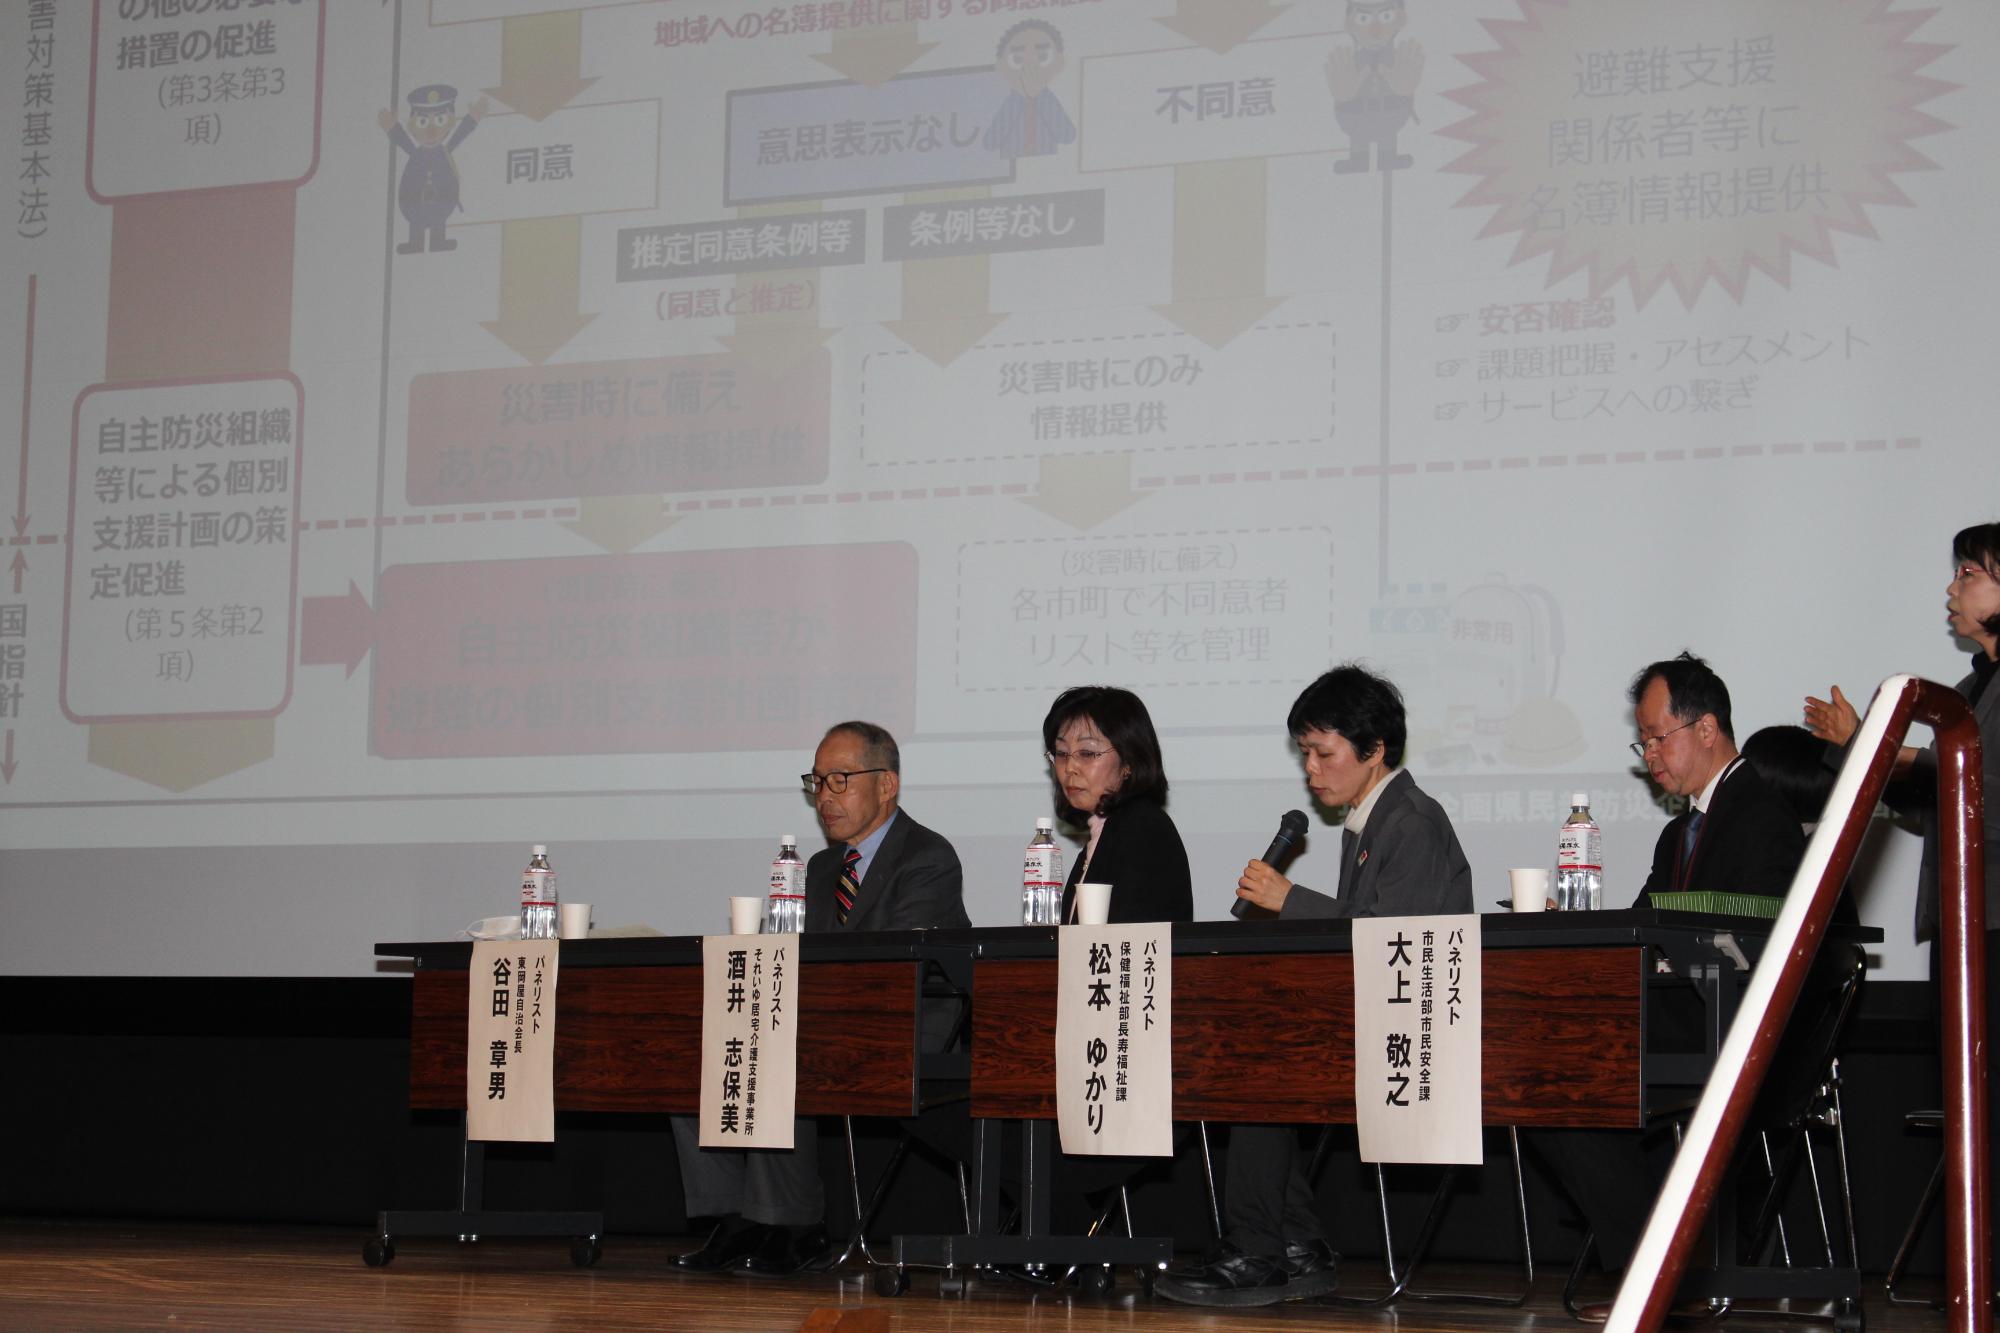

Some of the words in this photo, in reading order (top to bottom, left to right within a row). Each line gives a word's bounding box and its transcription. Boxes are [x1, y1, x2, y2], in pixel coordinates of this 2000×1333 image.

[116, 19, 277, 70] 措置の促進
[1571, 33, 1777, 101] 避難支援
[158, 67, 286, 109] (第3条第3
[1154, 77, 1277, 125] 不同意
[183, 113, 222, 145] 項)
[756, 111, 980, 166] 意思表示なし
[1548, 104, 1802, 168] 関係者等に
[505, 143, 575, 184] 同意
[1522, 162, 1833, 235] 名簿情報提供
[631, 219, 852, 269] 推定同意条例等
[909, 203, 1076, 247] 条例等なし
[656, 279, 817, 320] (同意と推定)
[1477, 297, 1617, 336] 安否確認
[998, 353, 1203, 396] 災害時にのみ
[1476, 325, 1871, 382] 課題把握・アセスメント
[501, 367, 742, 426] 災害時に備え
[1030, 401, 1168, 440] 情報提供
[1476, 373, 1760, 425] サービスへの繋ぎ
[97, 408, 293, 455] 自主防災組織
[95, 456, 288, 505] 等による個別
[92, 505, 288, 553] 支援計画の策
[88, 559, 186, 601] 定促進
[1060, 541, 1239, 577] (災害時に備え)
[125, 606, 265, 642] (第5条第2
[1009, 576, 1289, 624] 各市町で不同意者
[155, 650, 195, 682] 項)
[1030, 625, 1272, 668] リスト等を管理
[492, 957, 512, 1018] 谷田
[727, 950, 747, 1013] 酒井
[1087, 942, 1112, 1012] 松本
[1387, 931, 1413, 1004] 大上
[1447, 928, 1464, 1026] パネリスト
[514, 956, 527, 1054] 東岡屋自治会長
[1115, 941, 1131, 1102] 保健福祉部長寿福祉課
[1418, 930, 1435, 1102] 市民生活部市民安全課
[744, 948, 763, 1136] それいゆ居宅介護支援事業所
[488, 1039, 508, 1100] 章男
[720, 1037, 744, 1134] 志保美
[1085, 1037, 1108, 1135] ゆかり
[1385, 1033, 1412, 1107] 敬之
